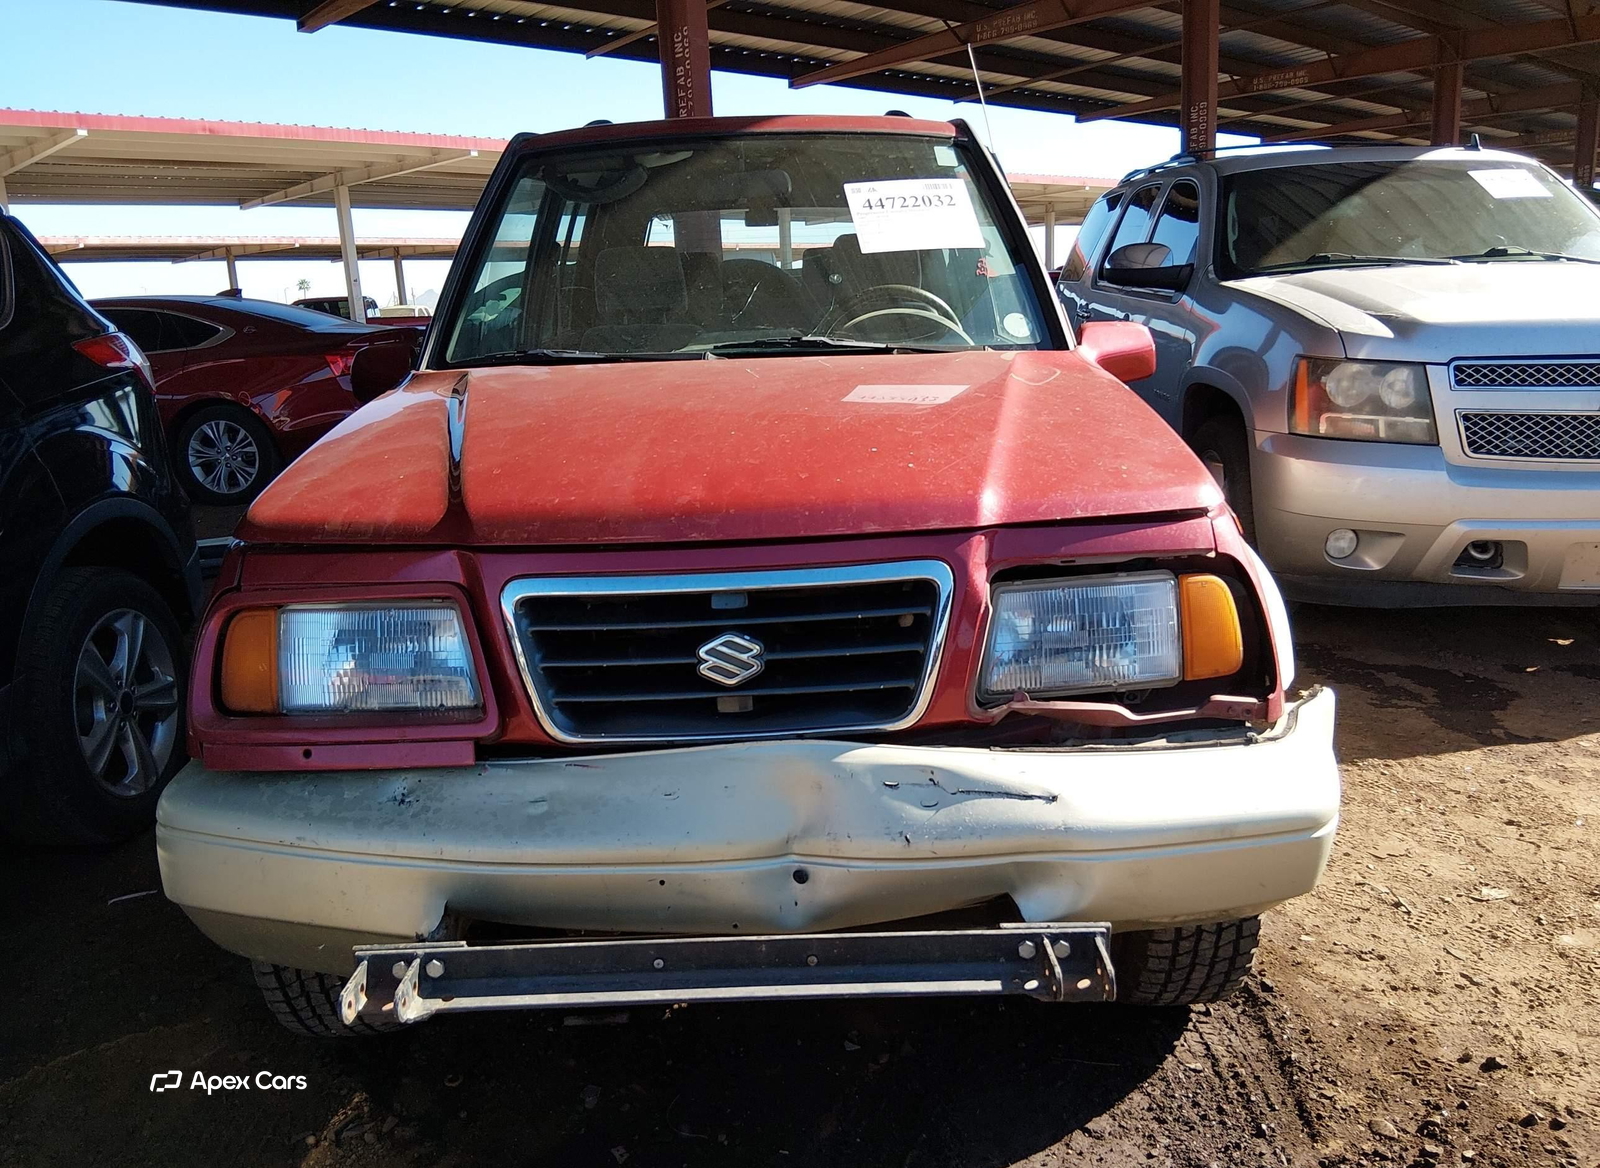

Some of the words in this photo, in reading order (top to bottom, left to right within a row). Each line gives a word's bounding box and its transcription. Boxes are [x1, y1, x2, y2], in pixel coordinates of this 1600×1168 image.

[674, 27, 683, 58] INC.
[677, 66, 687, 117] REFAB
[1190, 102, 1198, 122] INC.
[1199, 102, 1207, 148] 99-0969
[862, 194, 956, 210] 44722032
